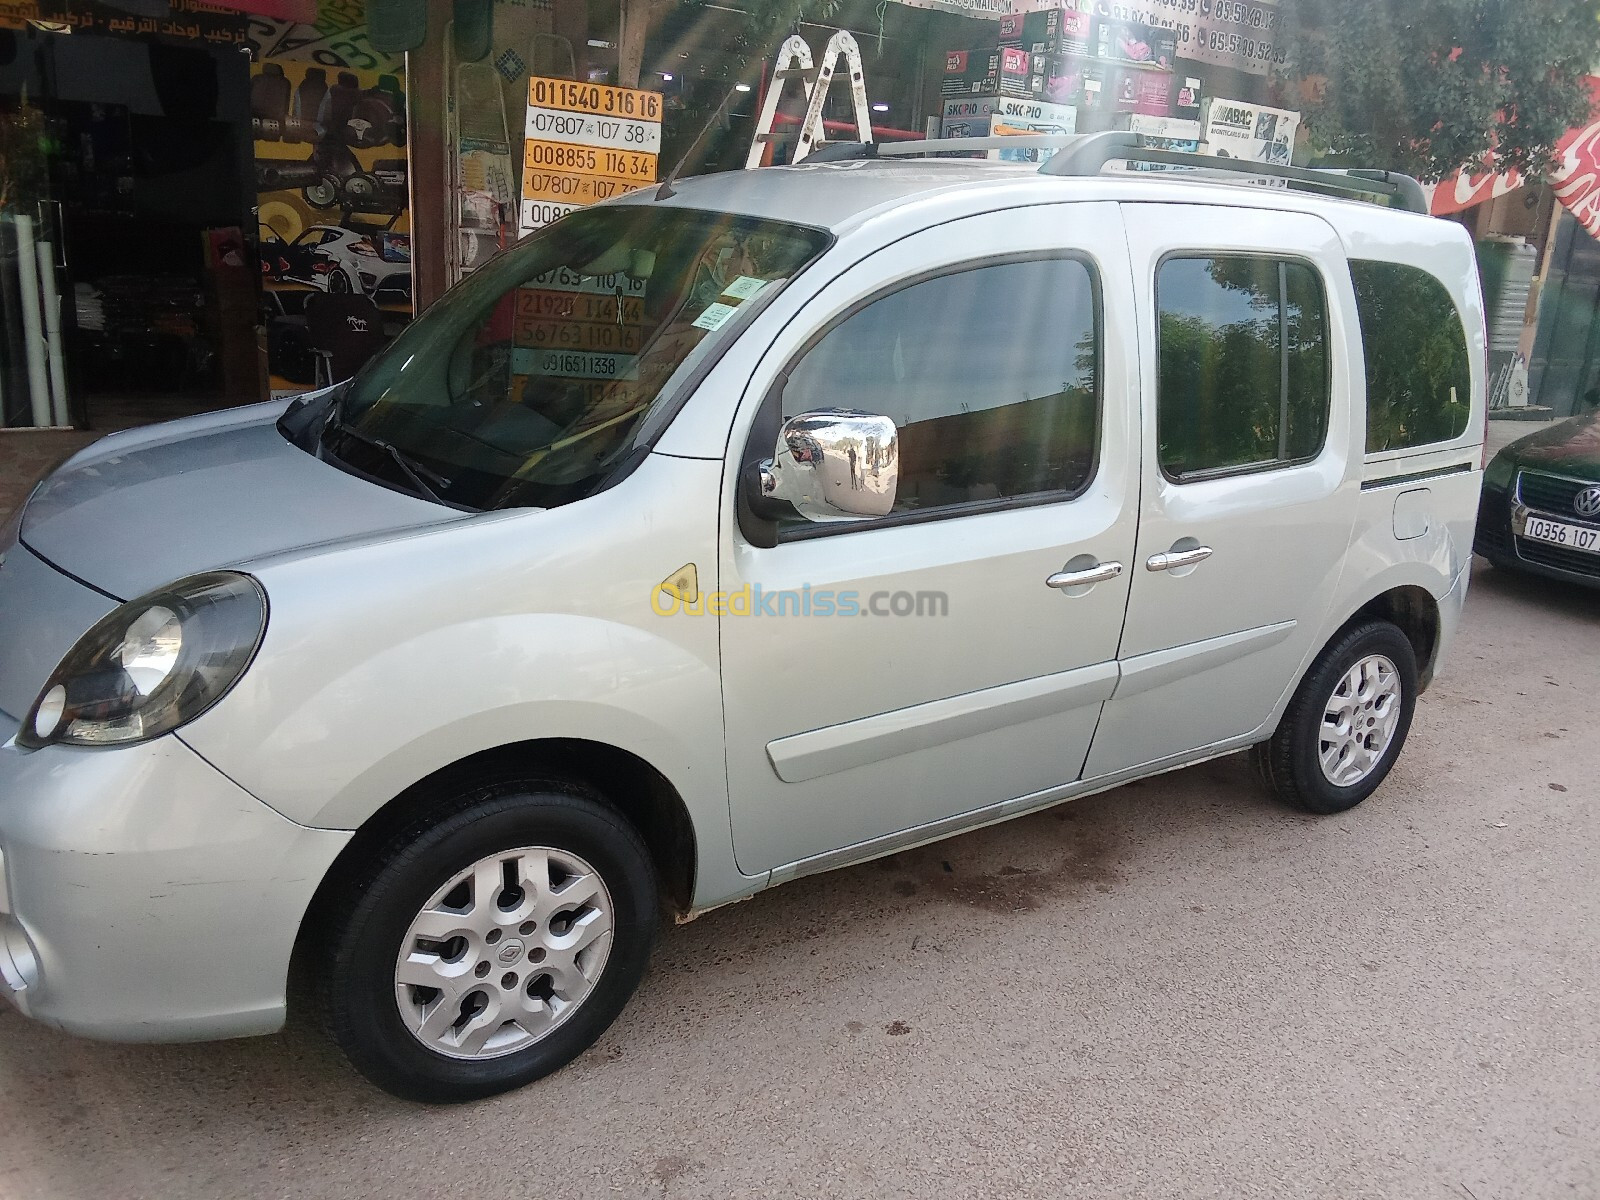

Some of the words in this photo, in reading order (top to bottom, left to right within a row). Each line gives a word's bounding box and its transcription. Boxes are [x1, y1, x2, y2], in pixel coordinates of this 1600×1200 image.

[161, 21, 201, 40] لوحات
[535, 80, 600, 110] 011540
[604, 88, 635, 114] 316
[639, 94, 657, 118] 16
[536, 113, 585, 136] 07807
[596, 121, 620, 139] 107
[624, 124, 645, 143] 38
[1224, 107, 1253, 126] ABAC
[533, 144, 596, 170] 008855
[605, 152, 626, 173] 116
[629, 155, 649, 175] 34
[531, 174, 581, 195] 07807
[592, 180, 616, 199] 107
[522, 322, 581, 344] 56763
[588, 326, 613, 346] 110
[618, 329, 634, 348] 16
[1529, 520, 1567, 543] 10356
[1572, 529, 1598, 548] 107
